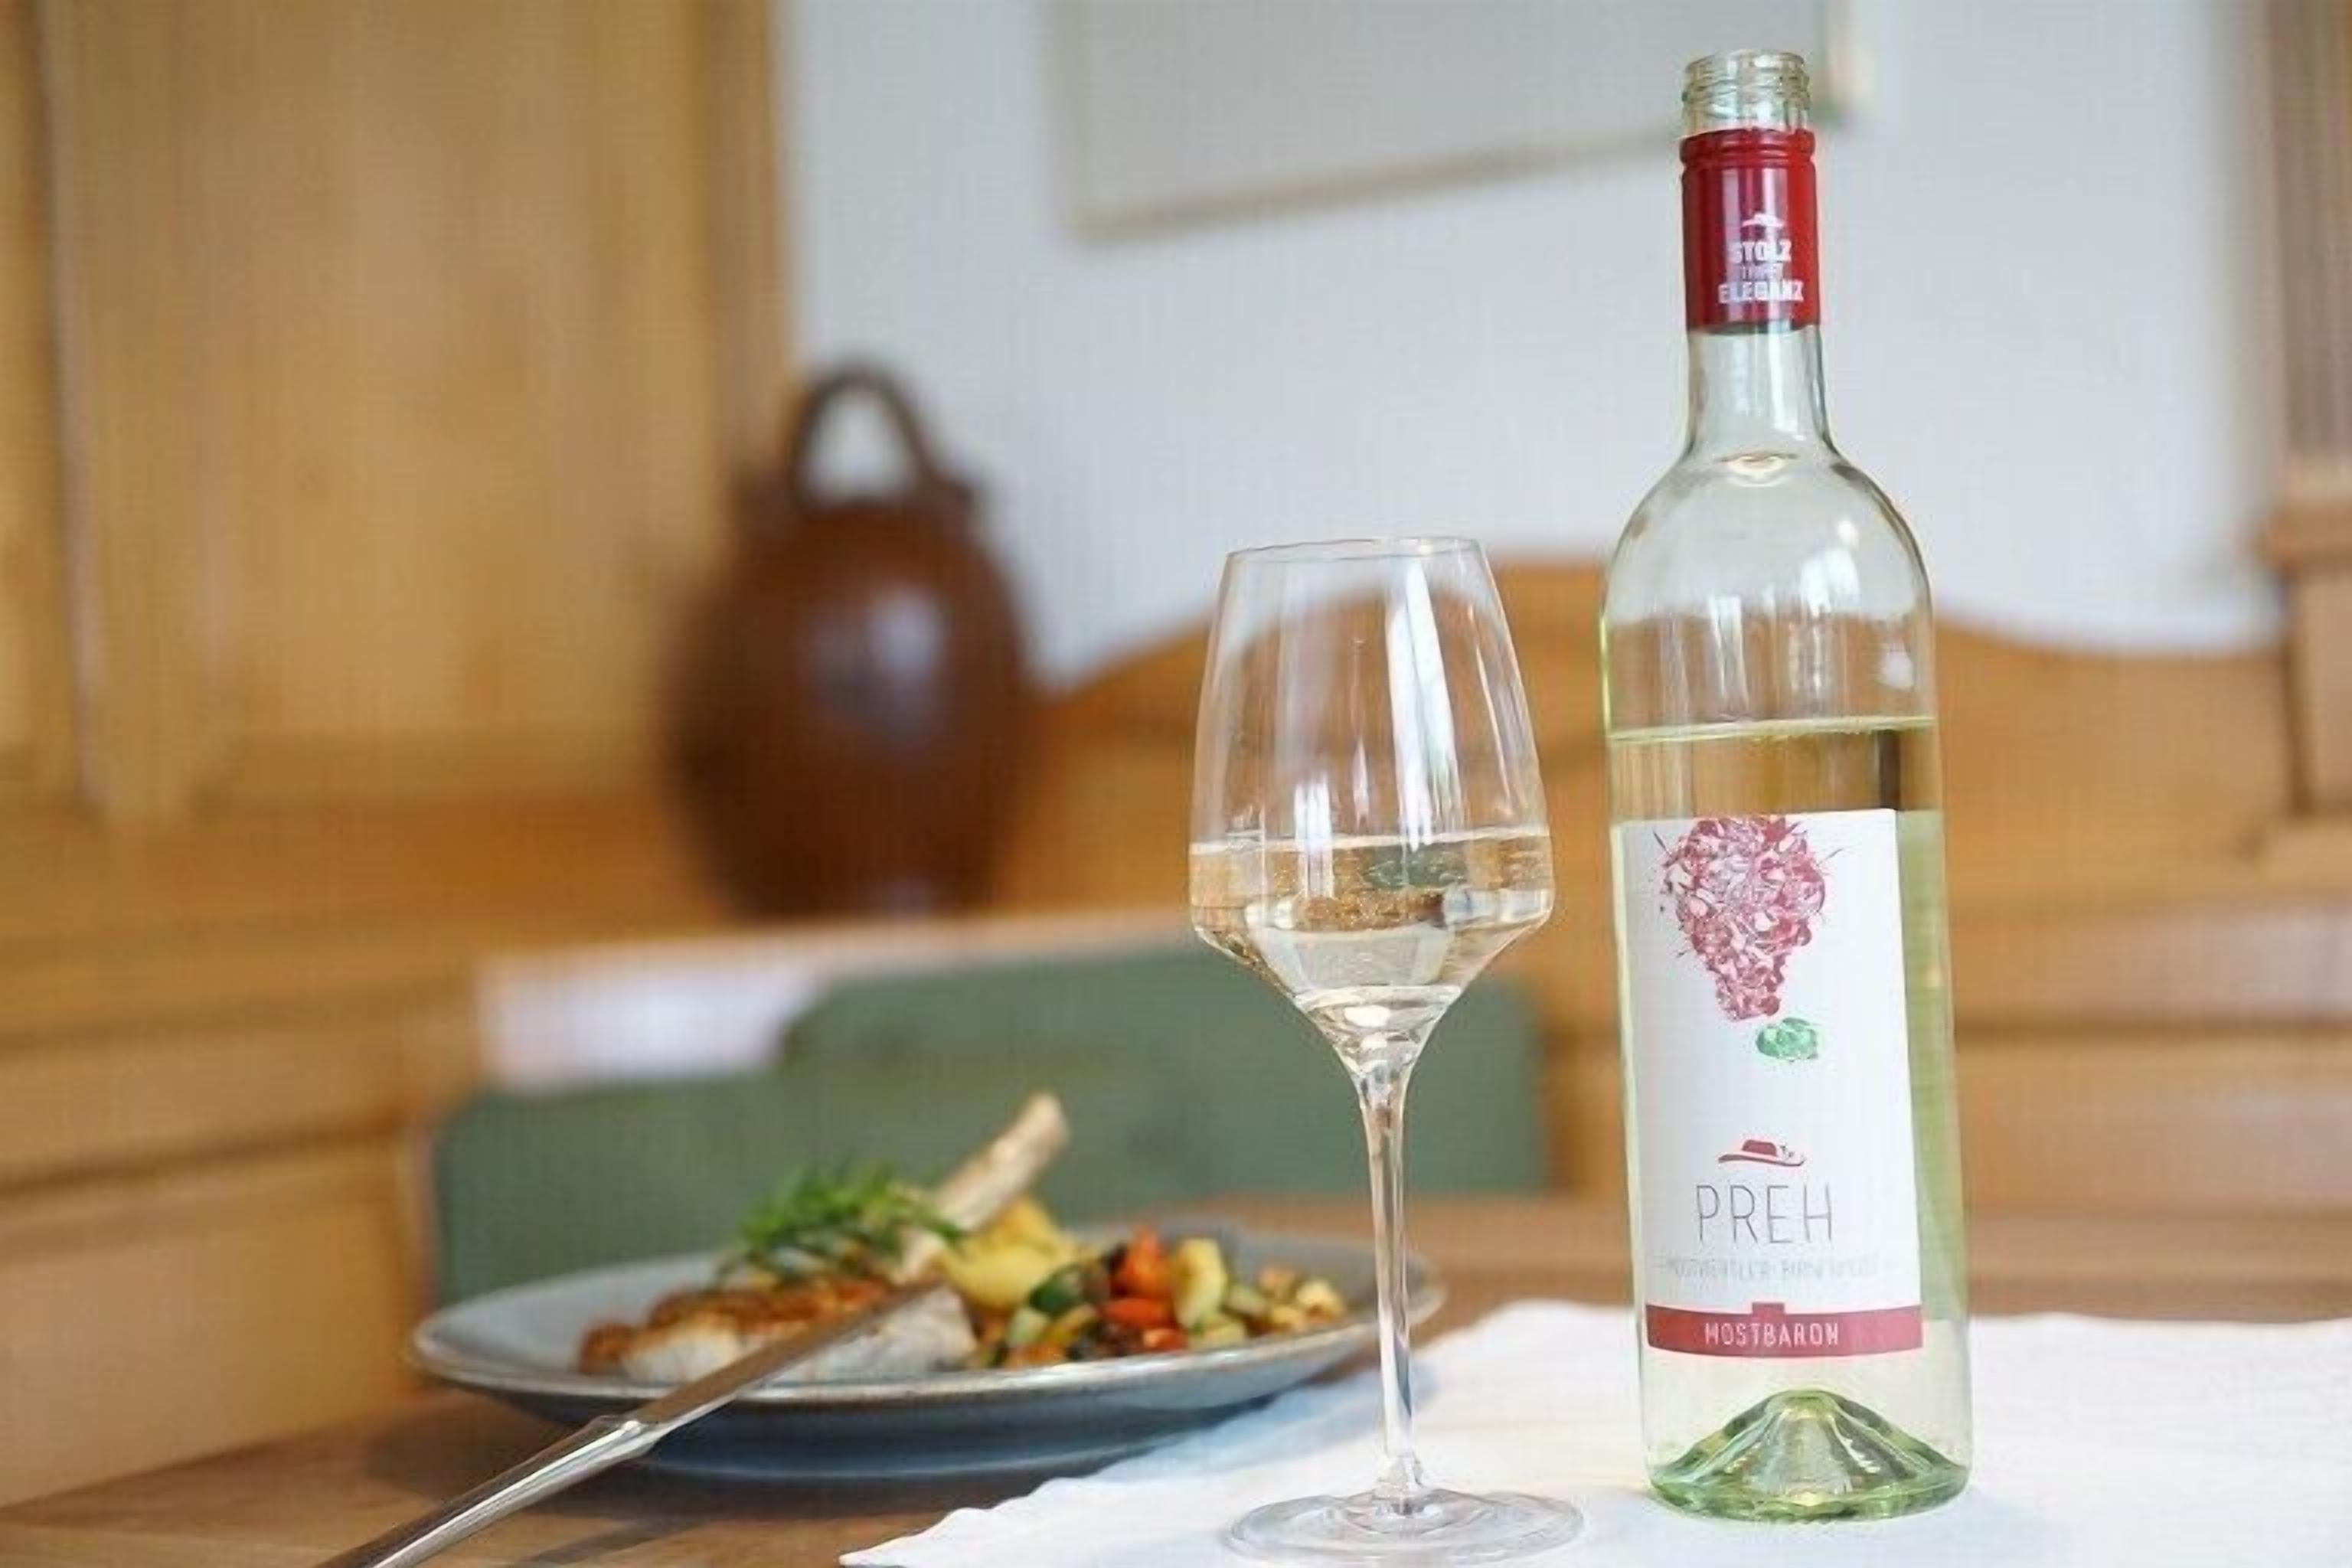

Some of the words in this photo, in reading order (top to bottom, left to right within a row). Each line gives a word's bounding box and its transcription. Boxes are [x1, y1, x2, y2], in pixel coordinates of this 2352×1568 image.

[1728, 240, 1792, 263] STOLZ
[1718, 279, 1805, 304] ELEGANZ
[1695, 1183, 1833, 1244] PREH
[1704, 1321, 1839, 1348] MOSTBARON
